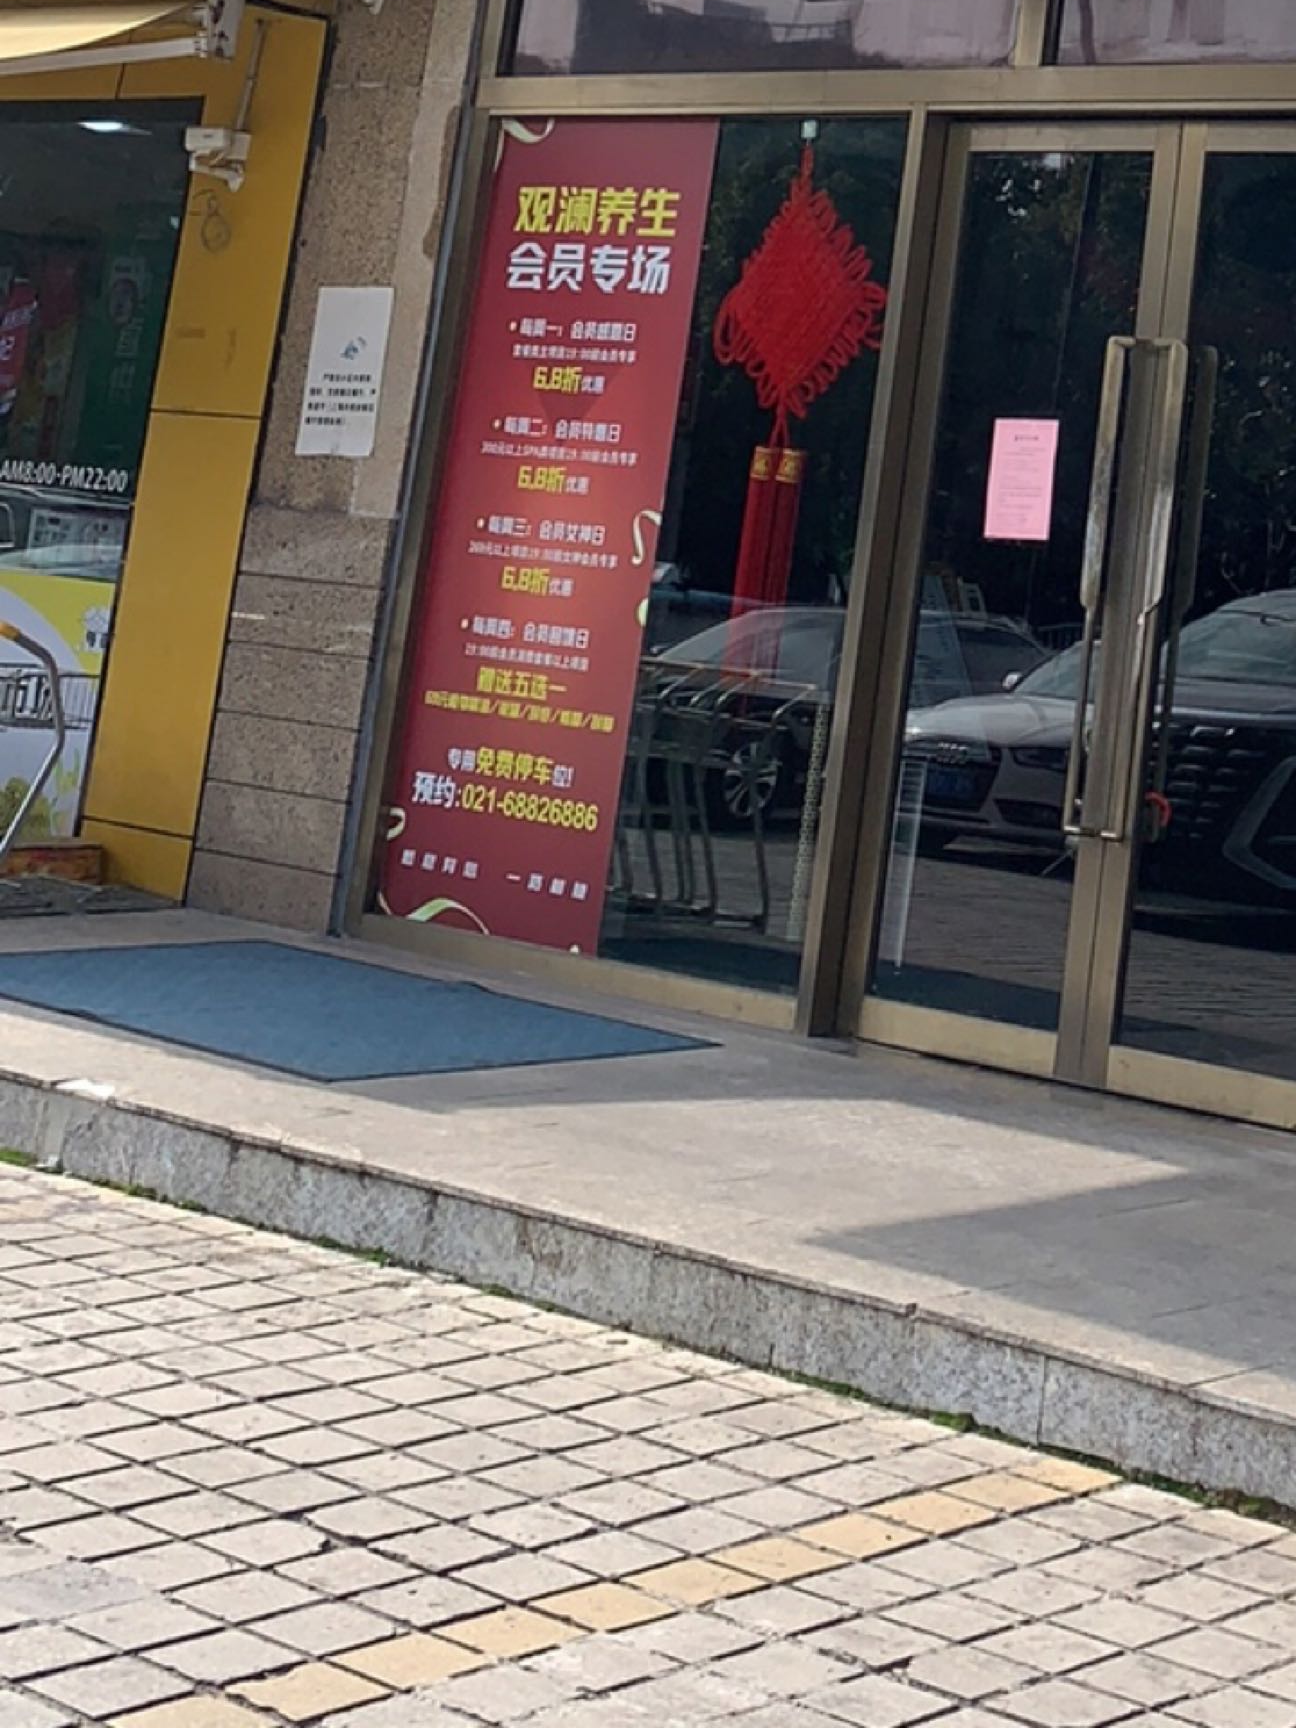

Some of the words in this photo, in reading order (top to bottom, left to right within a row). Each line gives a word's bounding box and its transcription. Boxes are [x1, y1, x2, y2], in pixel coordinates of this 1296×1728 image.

[513, 186, 681, 238] 观澜养生
[507, 242, 672, 295] 会员专场
